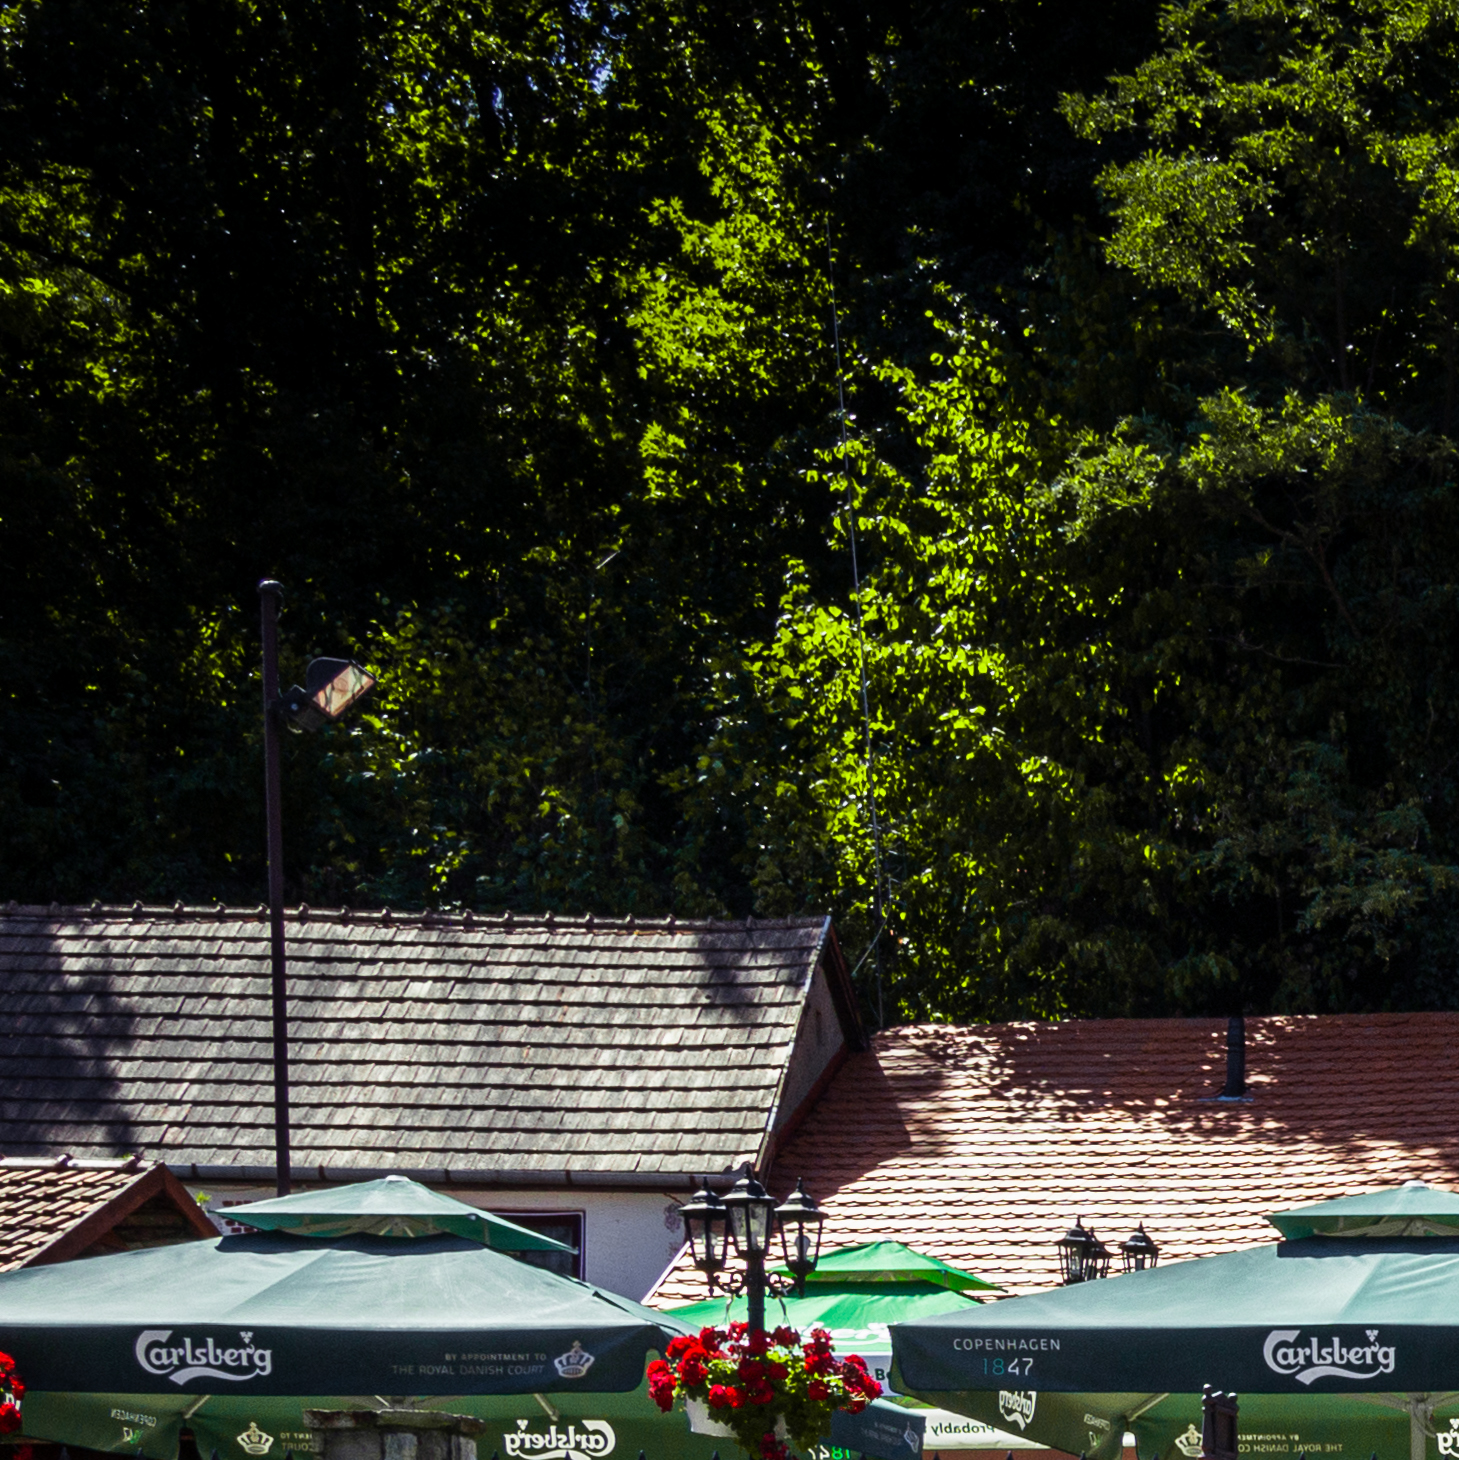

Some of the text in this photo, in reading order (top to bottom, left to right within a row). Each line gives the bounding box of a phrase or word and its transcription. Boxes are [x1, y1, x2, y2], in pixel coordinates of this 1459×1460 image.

[953, 1338, 1061, 1351] COPENHAGEN
[135, 1330, 273, 1385] Carlsberg
[445, 1353, 547, 1361] BY APPOINTMENT TO
[1263, 1329, 1396, 1385] Carlsberg
[392, 1364, 546, 1375] THE ROYAL DANISH COURT
[983, 1357, 1034, 1376] 1847
